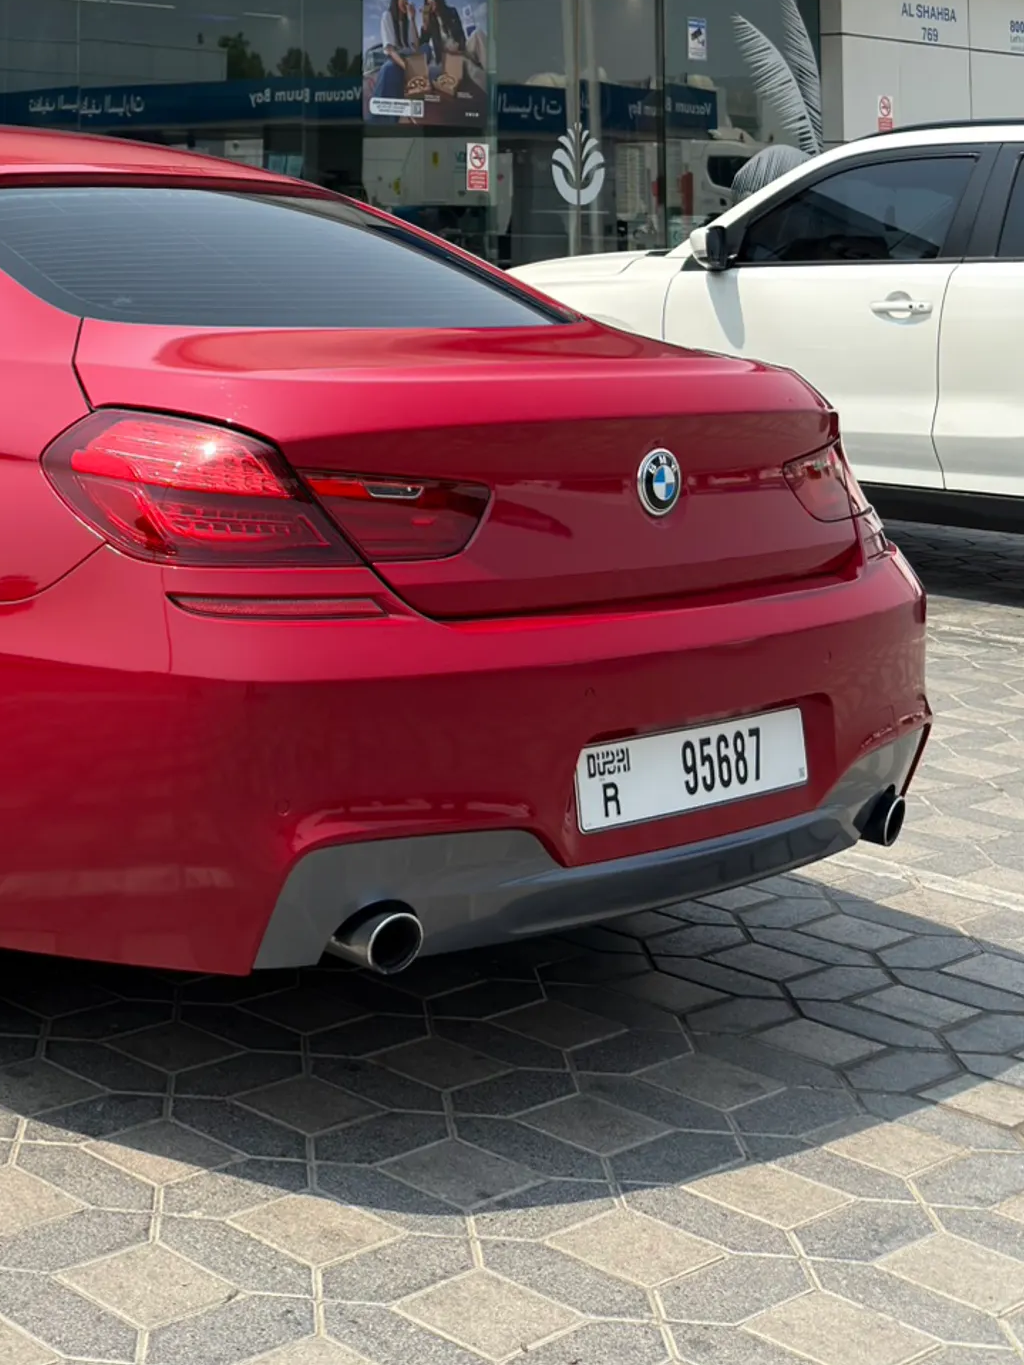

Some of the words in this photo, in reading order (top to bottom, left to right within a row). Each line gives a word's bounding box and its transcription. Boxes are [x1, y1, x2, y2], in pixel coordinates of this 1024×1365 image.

[901, 2, 914, 18] AL
[916, 4, 957, 22] SHAHBA
[921, 27, 939, 42] 769
[681, 727, 761, 796] 95687
[602, 782, 621, 818] R
